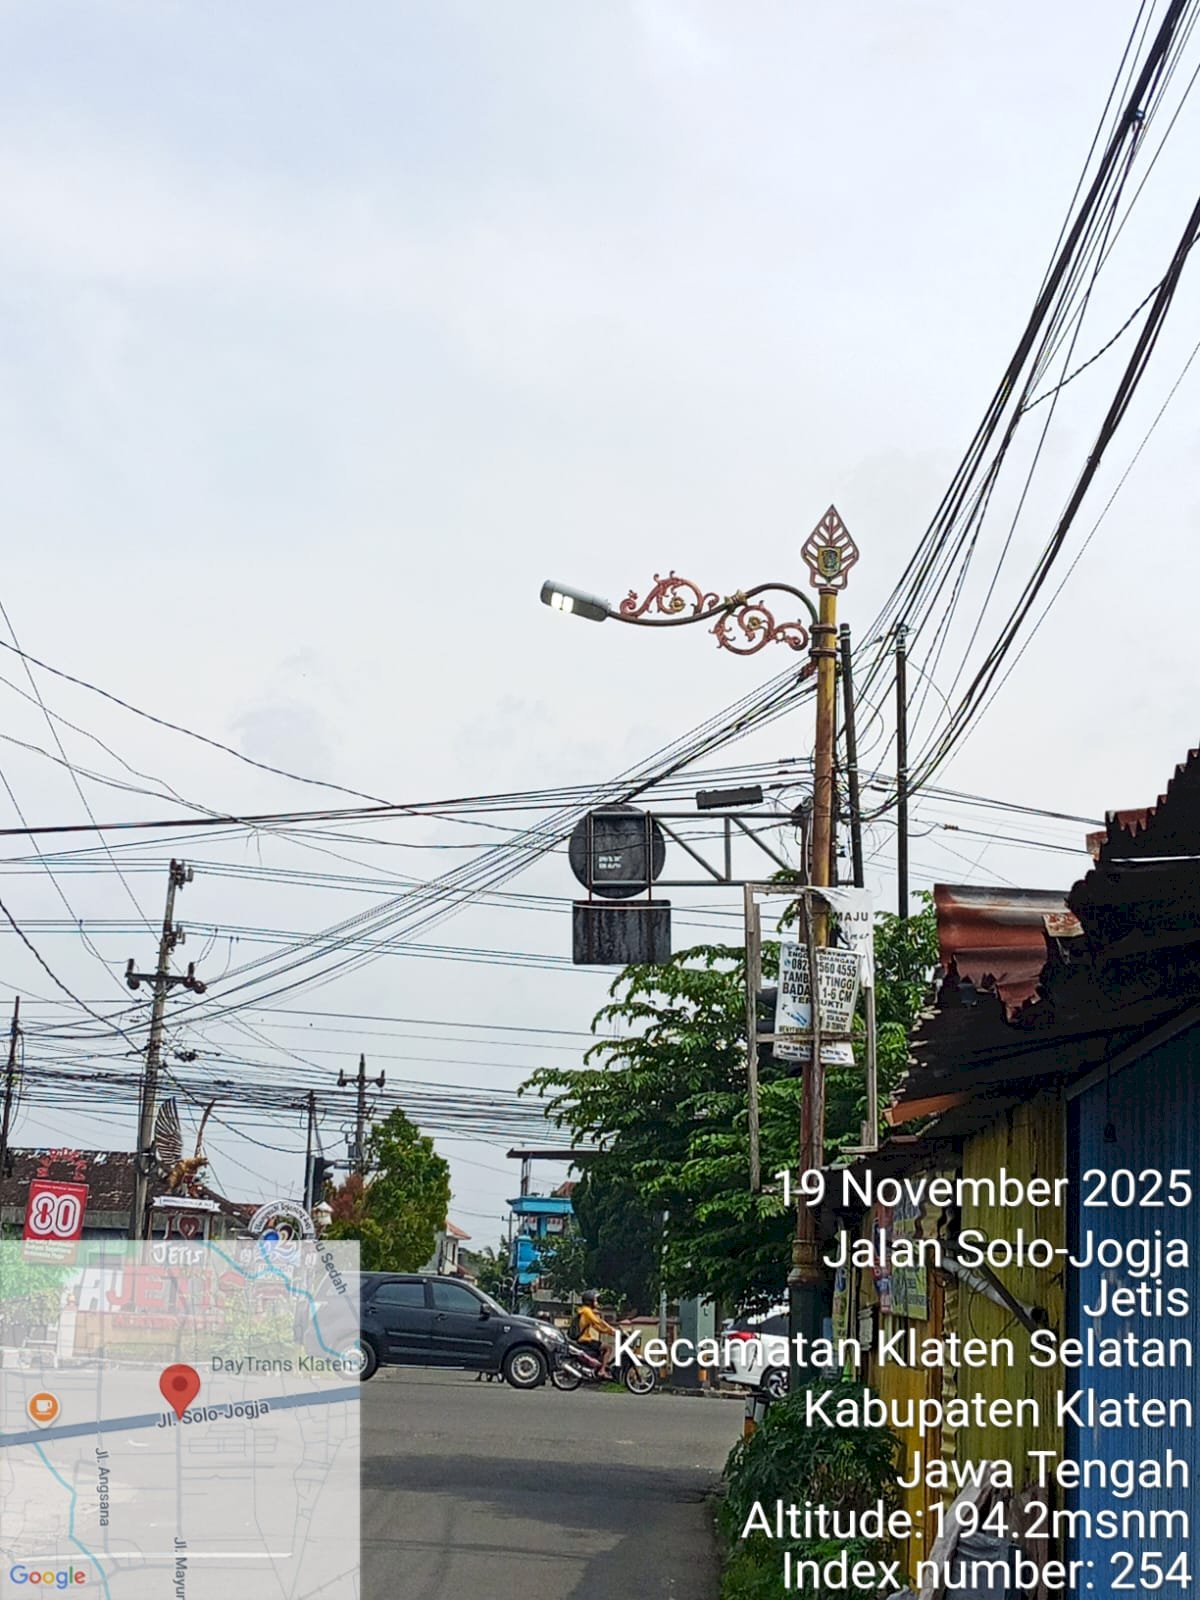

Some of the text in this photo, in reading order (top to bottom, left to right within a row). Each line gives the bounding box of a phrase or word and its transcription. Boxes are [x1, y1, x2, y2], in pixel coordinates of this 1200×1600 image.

[837, 964, 857, 978] 4555
[825, 975, 856, 991] TINGGI
[782, 982, 811, 996] BADA
[839, 989, 854, 1003] CM
[29, 1191, 82, 1238] 80
